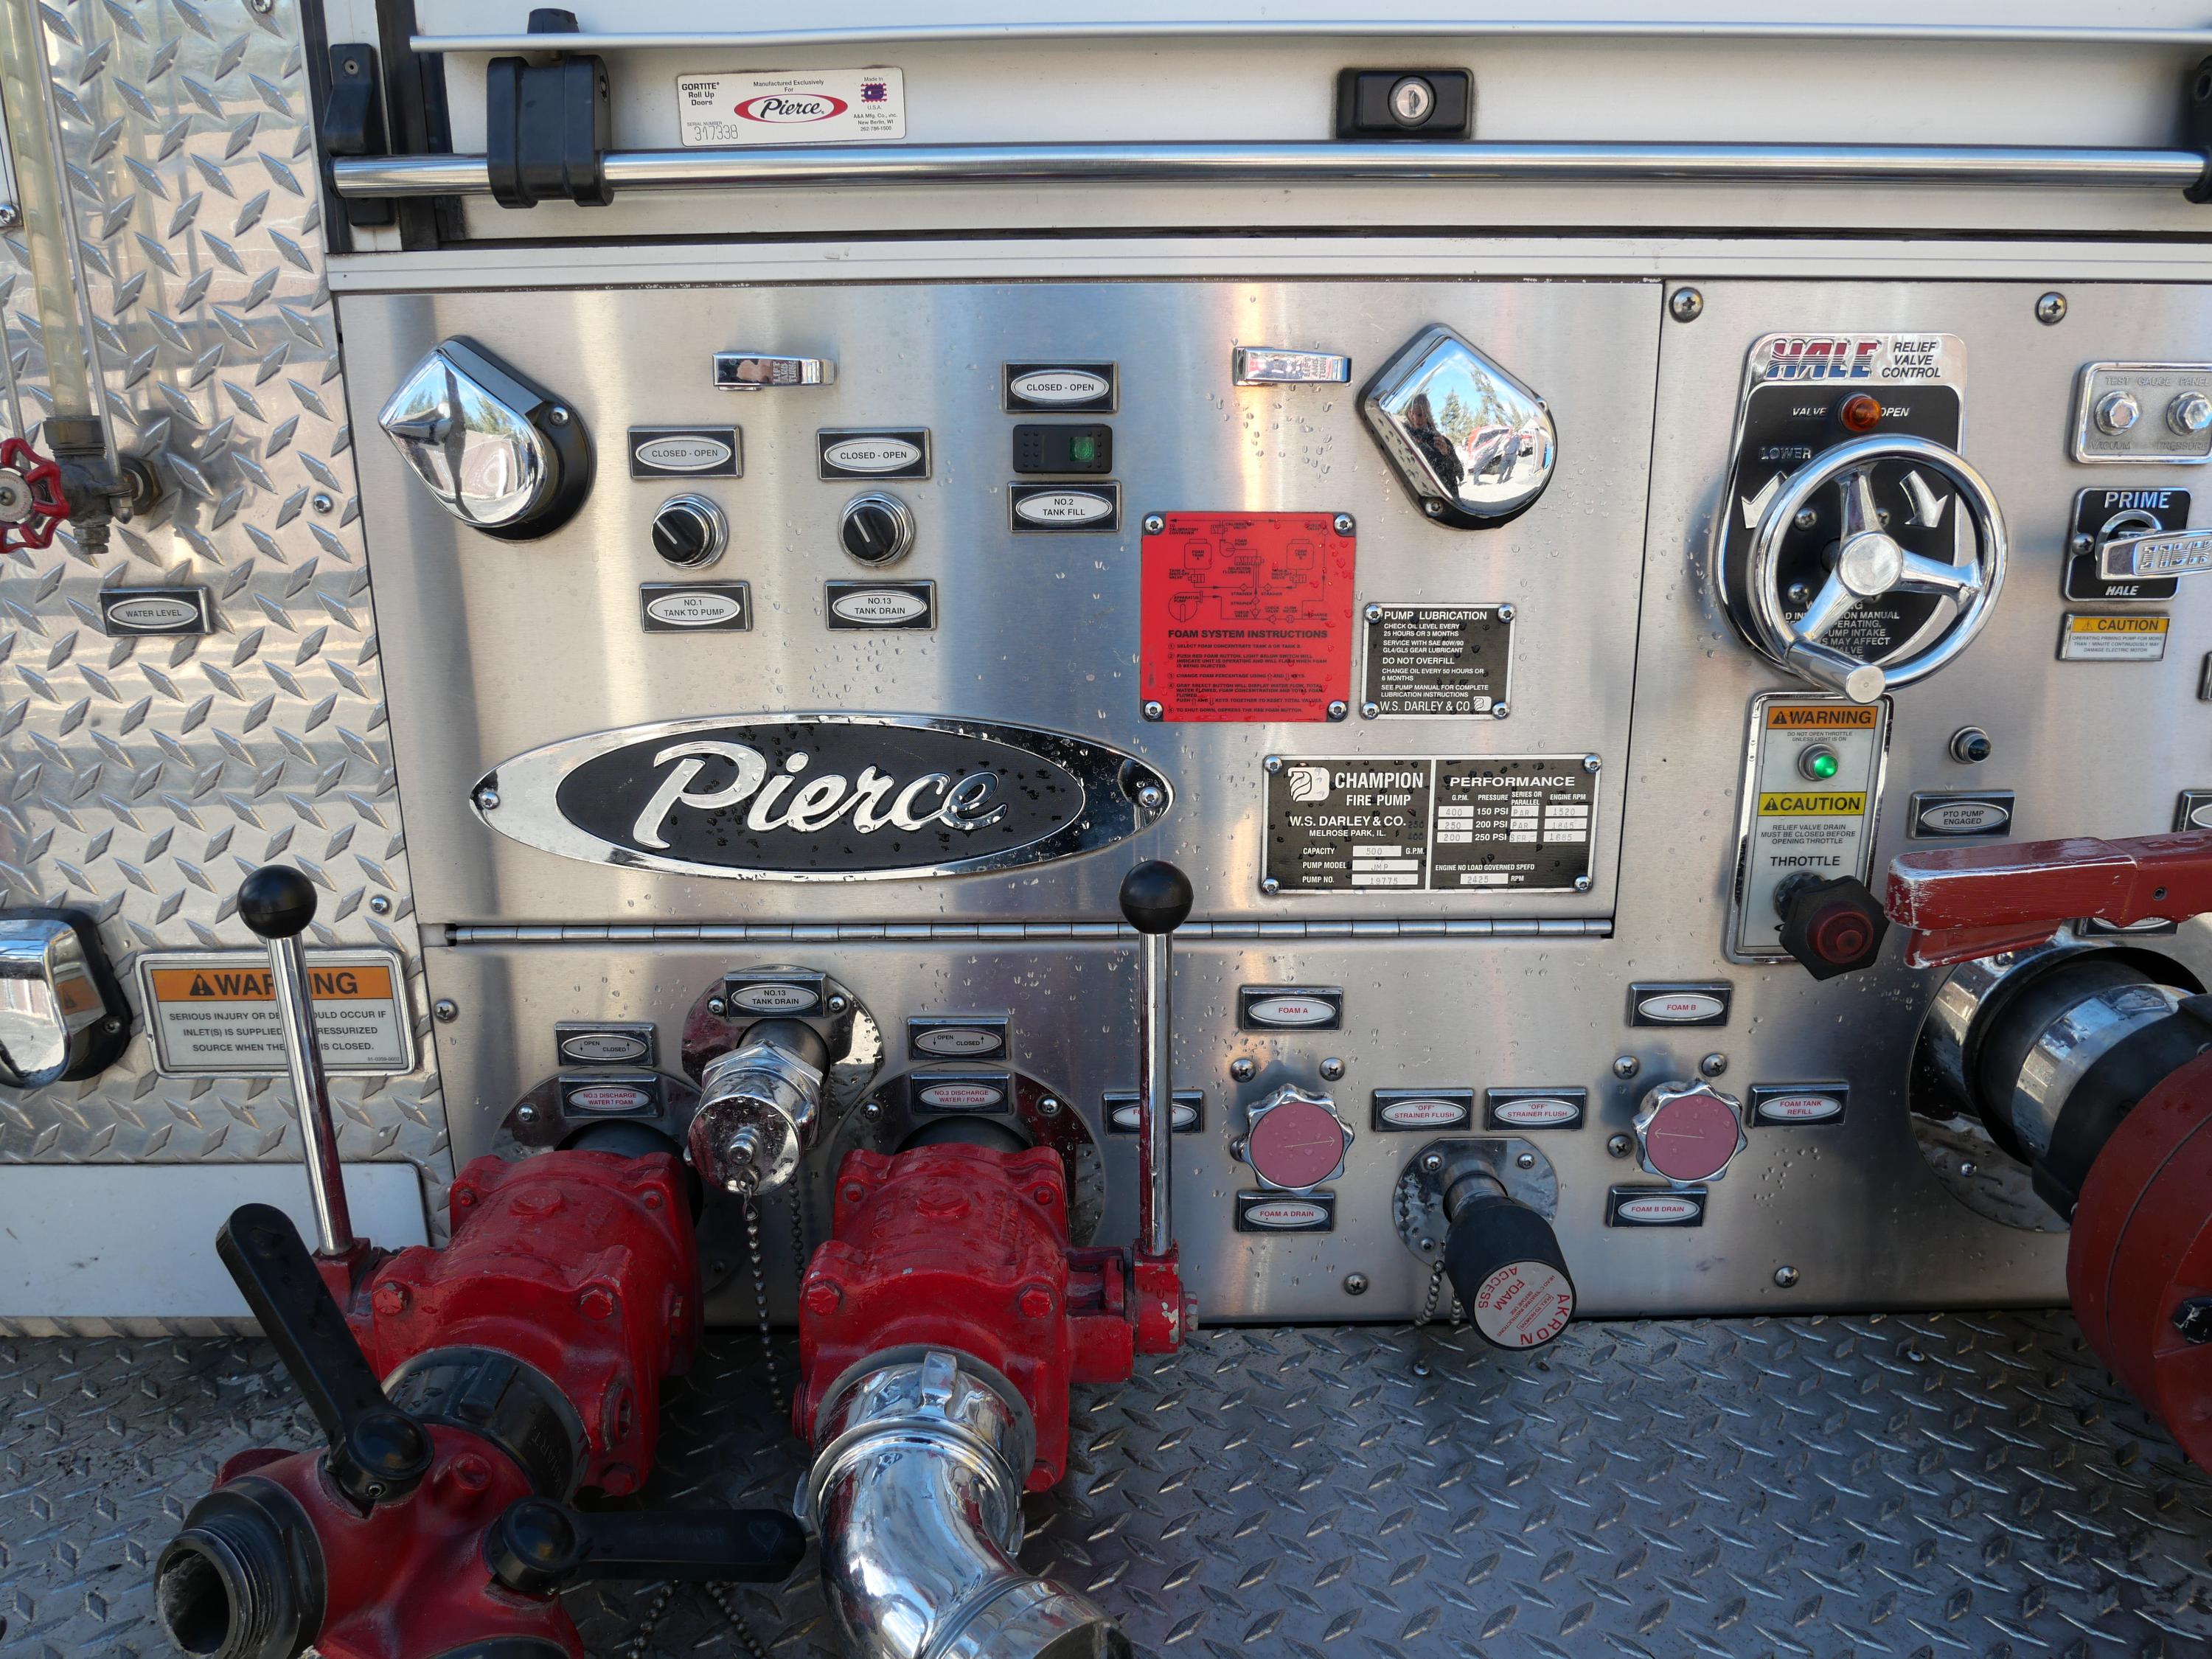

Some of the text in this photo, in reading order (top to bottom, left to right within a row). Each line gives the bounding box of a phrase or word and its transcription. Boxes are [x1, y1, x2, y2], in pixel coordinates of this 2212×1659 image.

[695, 125, 738, 140] 317338
[1893, 342, 1937, 353] RELIEF
[1893, 355, 1933, 366] VALVE
[1881, 367, 1941, 378] CONTROL
[2106, 377, 2130, 385] TEST
[2178, 378, 2210, 386] PANEL
[1792, 408, 1826, 417] VALVE
[652, 449, 686, 457] CLOSED
[695, 449, 718, 457] OPEN
[840, 451, 875, 459] CLOSED
[883, 451, 907, 459] OPEN
[1759, 448, 1811, 459] LOWER
[2104, 492, 2171, 509] PRIME
[2106, 586, 2138, 596] HALE
[664, 607, 725, 616] TANK TO PUMP
[879, 606, 905, 614] DRAIN
[1385, 611, 1487, 620] PUMP LUBRICATION
[2098, 620, 2158, 630] CAUTION
[1380, 701, 1470, 711] W.S. DARLEY & CO
[1790, 711, 1871, 724] WARNING
[1335, 773, 1423, 788] CHAMPION
[1450, 777, 1575, 786] PERFORMANCE
[633, 741, 1009, 849] Pierce
[1346, 795, 1411, 806] FIRE PUMP
[1780, 797, 1860, 810] CAUTION
[1290, 816, 1405, 826] W.S. DARLEY & CO.
[1770, 856, 1840, 866] THROTTLE
[214, 1012, 248, 1020] INJURY
[340, 1011, 375, 1019] OCCUR
[184, 1028, 222, 1037] INLET(S)
[224, 1028, 234, 1036] IS
[237, 1027, 282, 1036] SUPPLIED
[333, 1042, 374, 1050] CLOSED.
[1478, 1266, 1518, 1309] ACCESS
[1494, 1279, 1525, 1311] FOAM
[1520, 1294, 1571, 1345] AKRON
